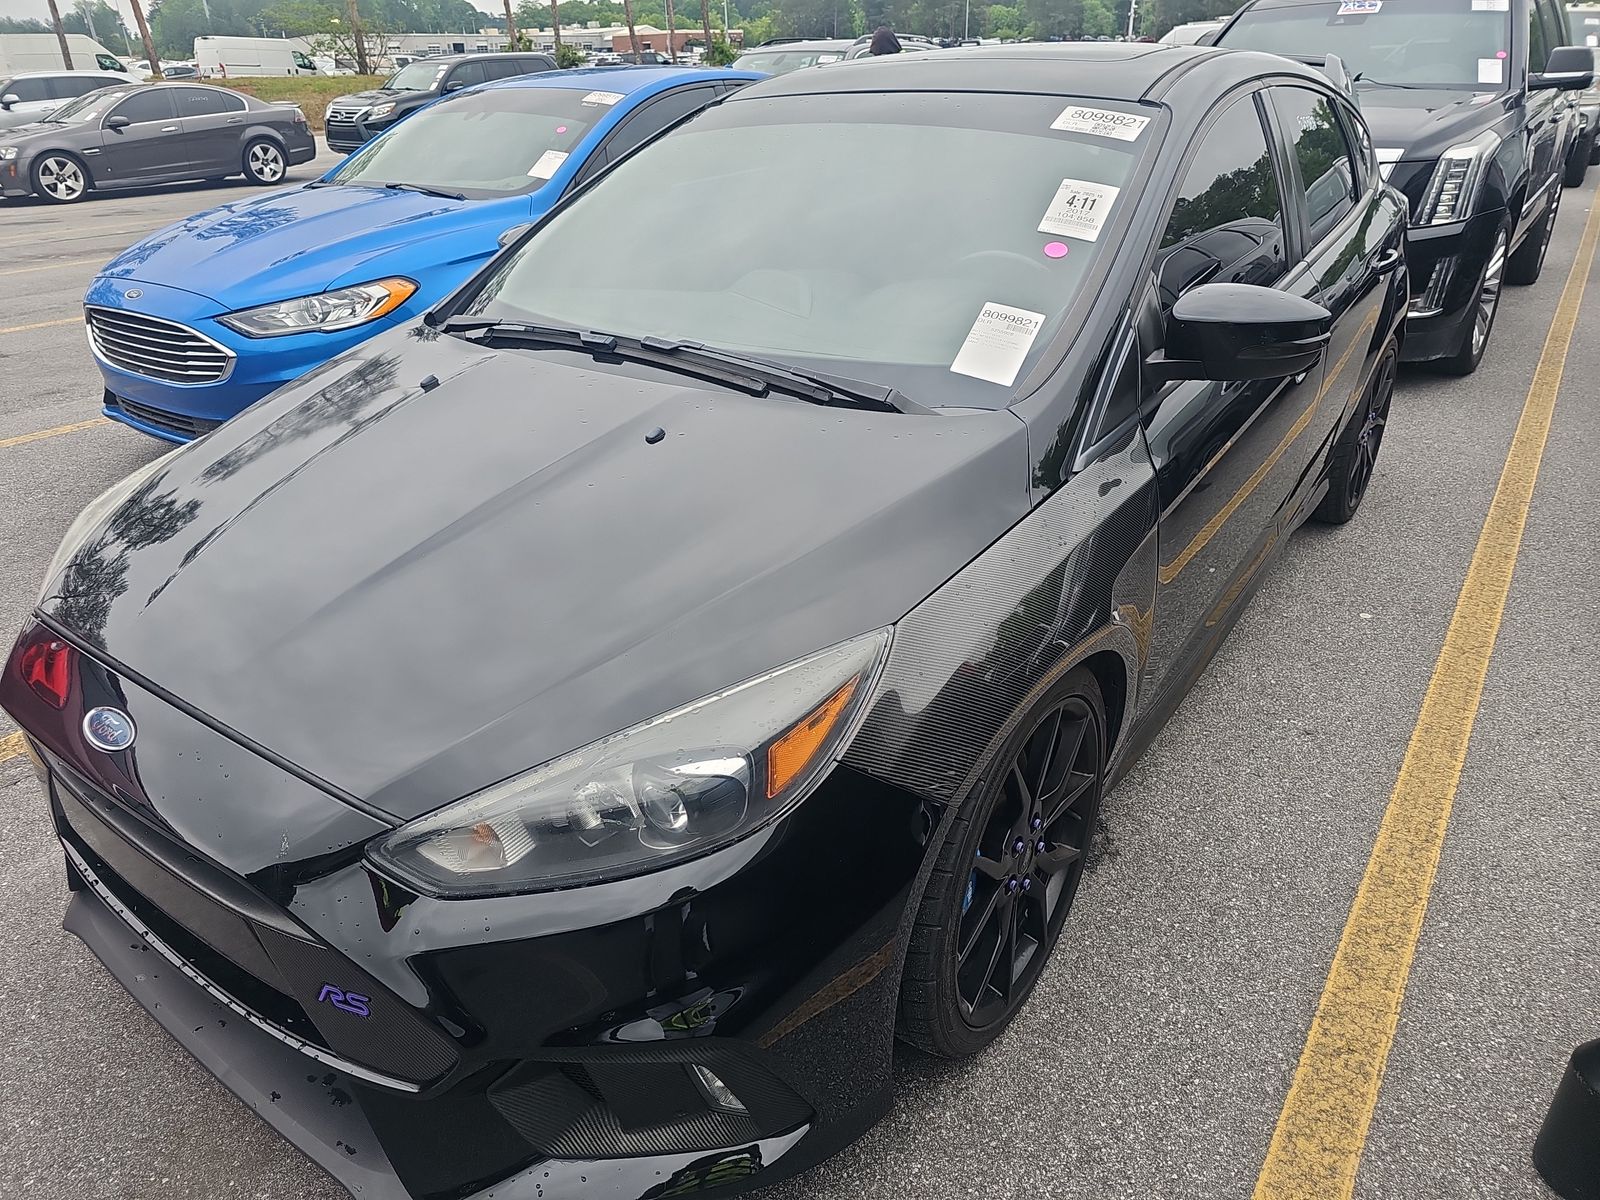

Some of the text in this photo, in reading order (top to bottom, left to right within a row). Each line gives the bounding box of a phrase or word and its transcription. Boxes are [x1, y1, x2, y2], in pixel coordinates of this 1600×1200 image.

[1071, 109, 1146, 129] 8099821
[1066, 195, 1097, 211] 4:11
[1066, 208, 1090, 216] 2017
[982, 309, 1039, 329] 8099821
[92, 714, 123, 742] Ford
[318, 984, 369, 1016] RS
